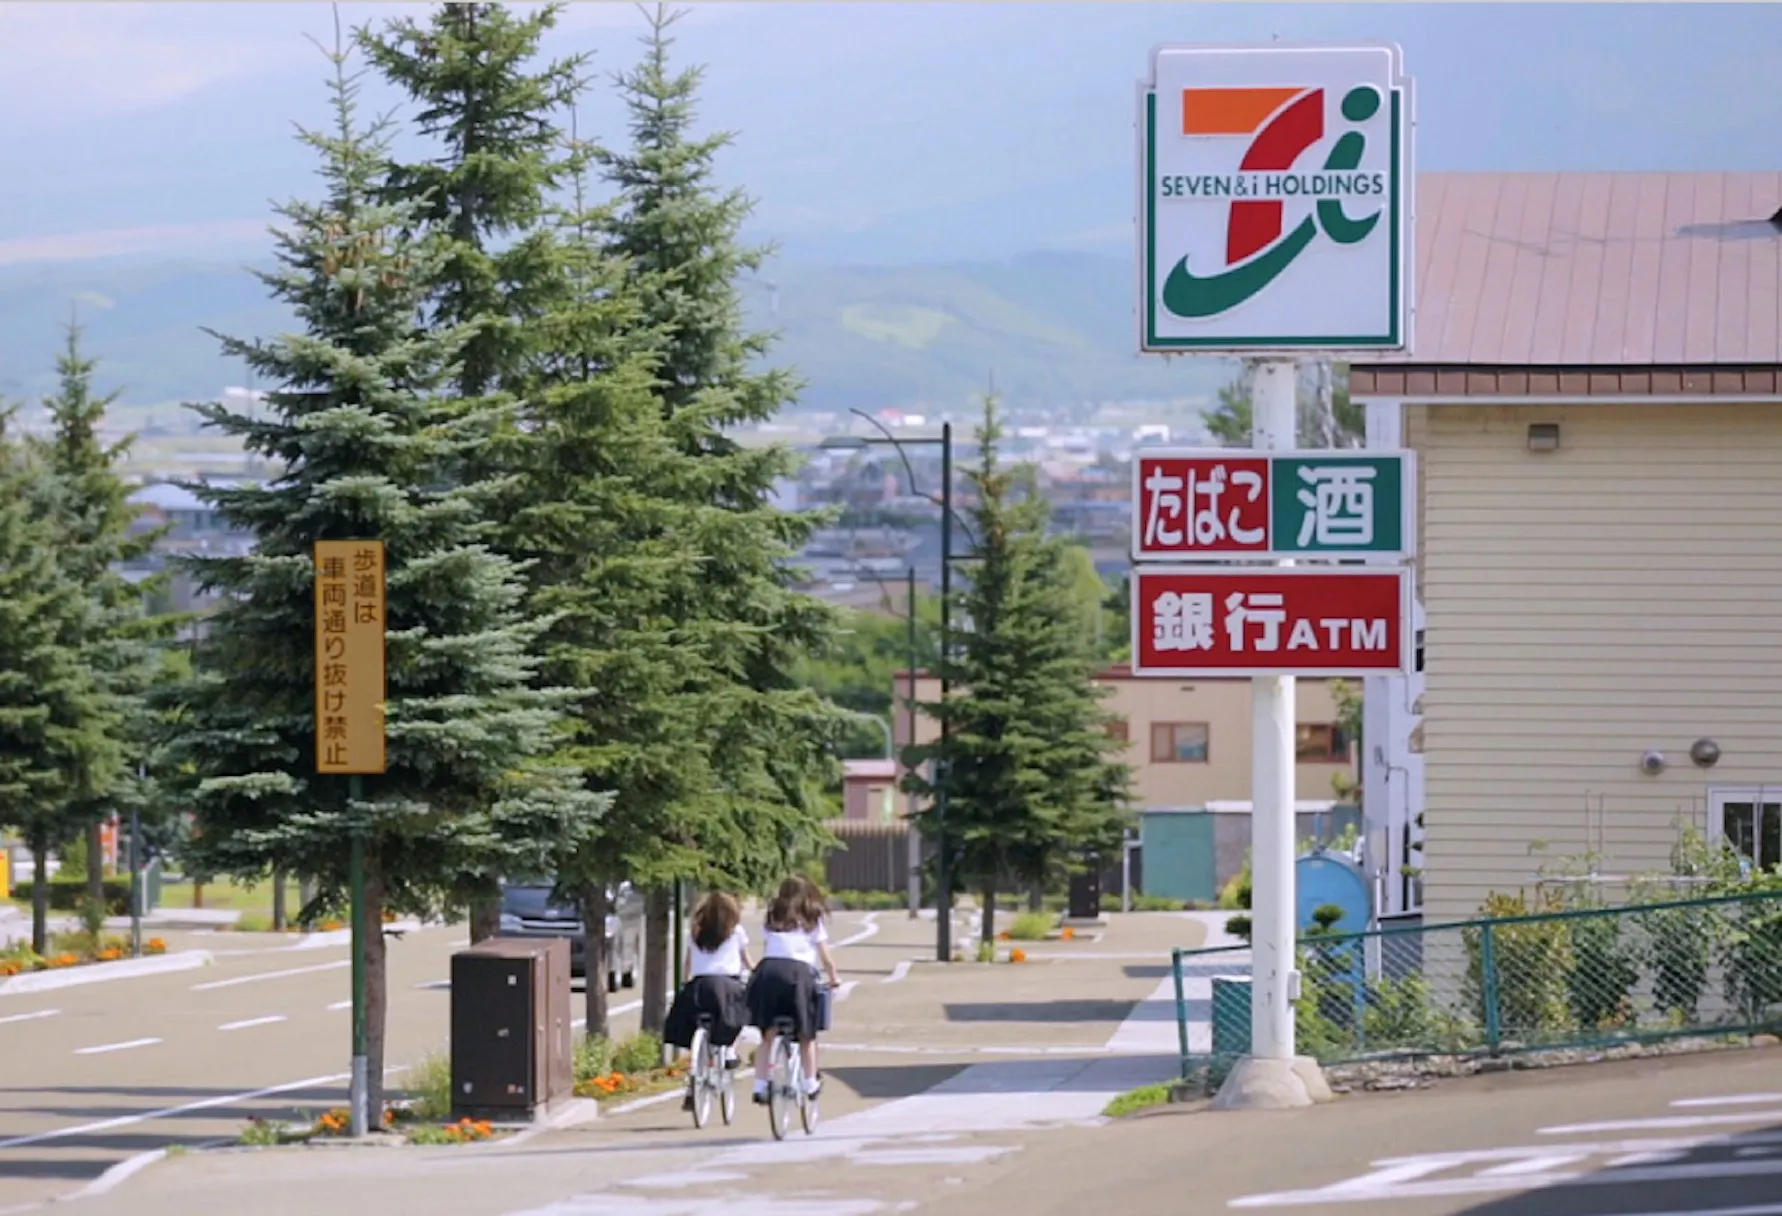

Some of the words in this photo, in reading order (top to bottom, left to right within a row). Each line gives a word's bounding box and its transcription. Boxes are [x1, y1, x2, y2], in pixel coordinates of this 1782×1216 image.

[1265, 173, 1384, 195] HOLDINGS
[1145, 464, 1265, 546] たばこ
[1297, 465, 1377, 548] 酒
[353, 549, 377, 624] 歩道は
[322, 557, 348, 766] 車両通り抜け禁止
